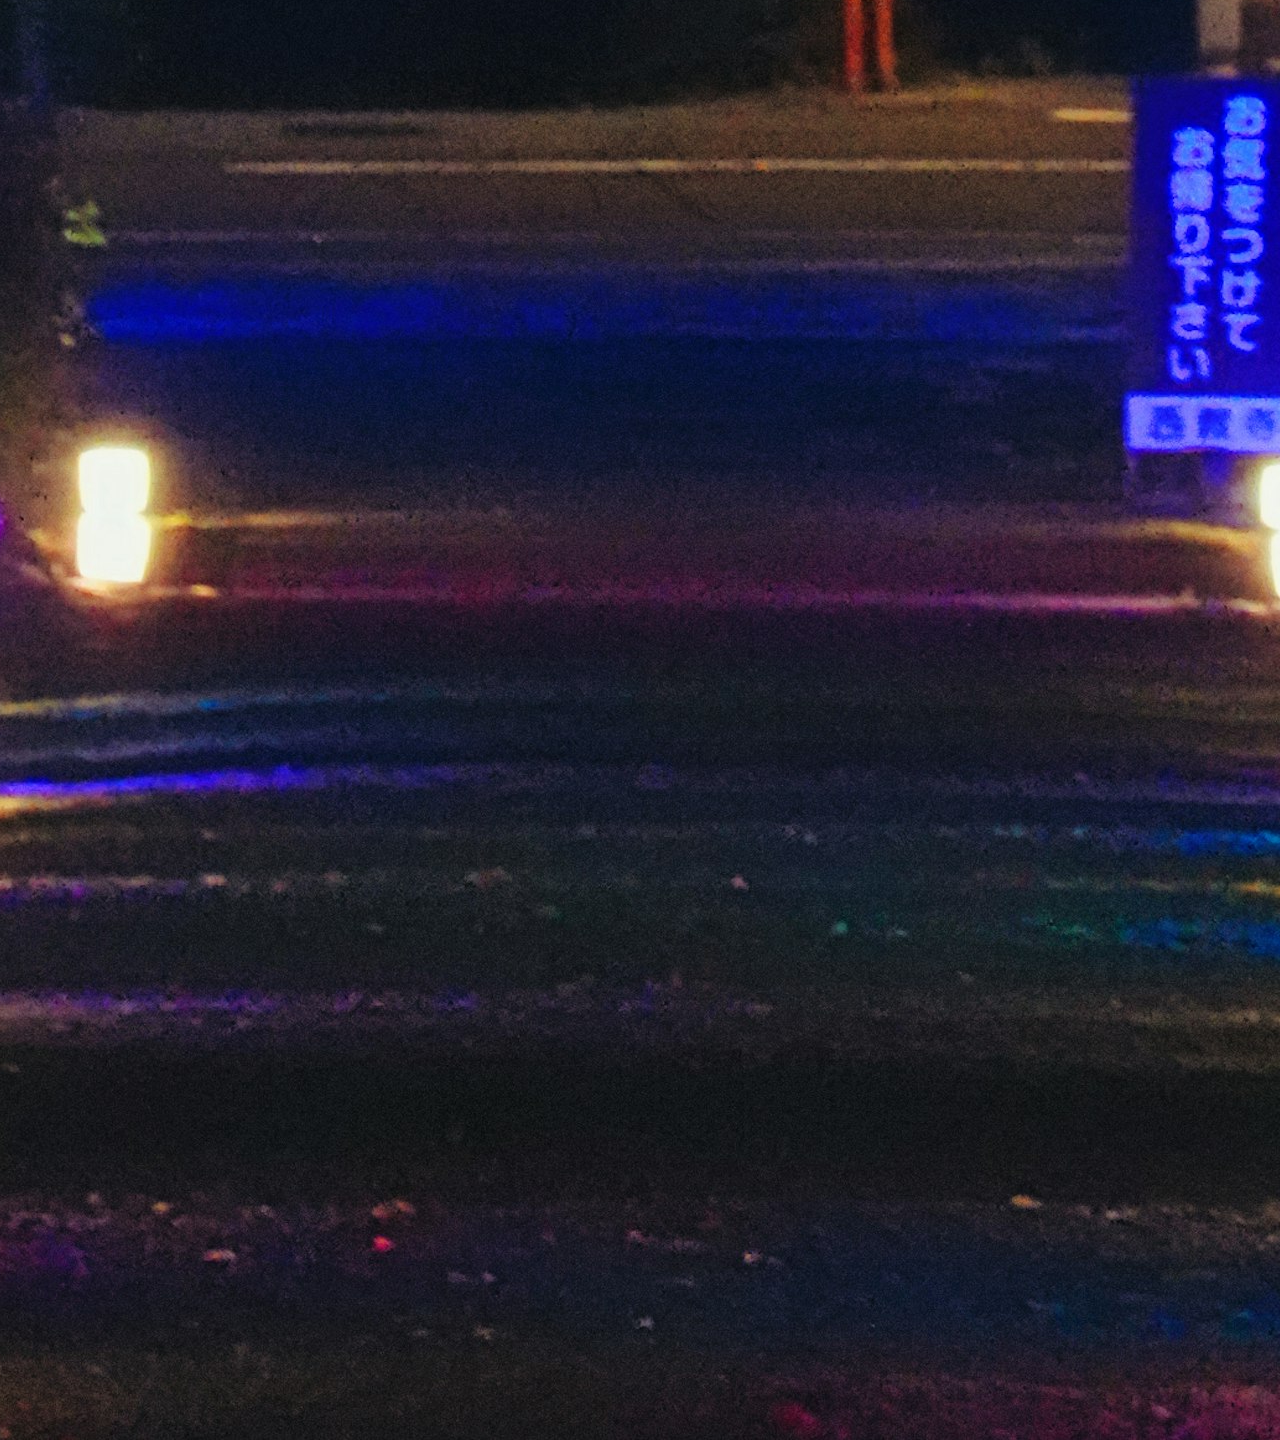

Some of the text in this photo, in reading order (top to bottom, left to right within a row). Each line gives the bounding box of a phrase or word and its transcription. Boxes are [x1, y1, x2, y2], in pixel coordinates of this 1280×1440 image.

[1169, 126, 1215, 381] おり下さい
